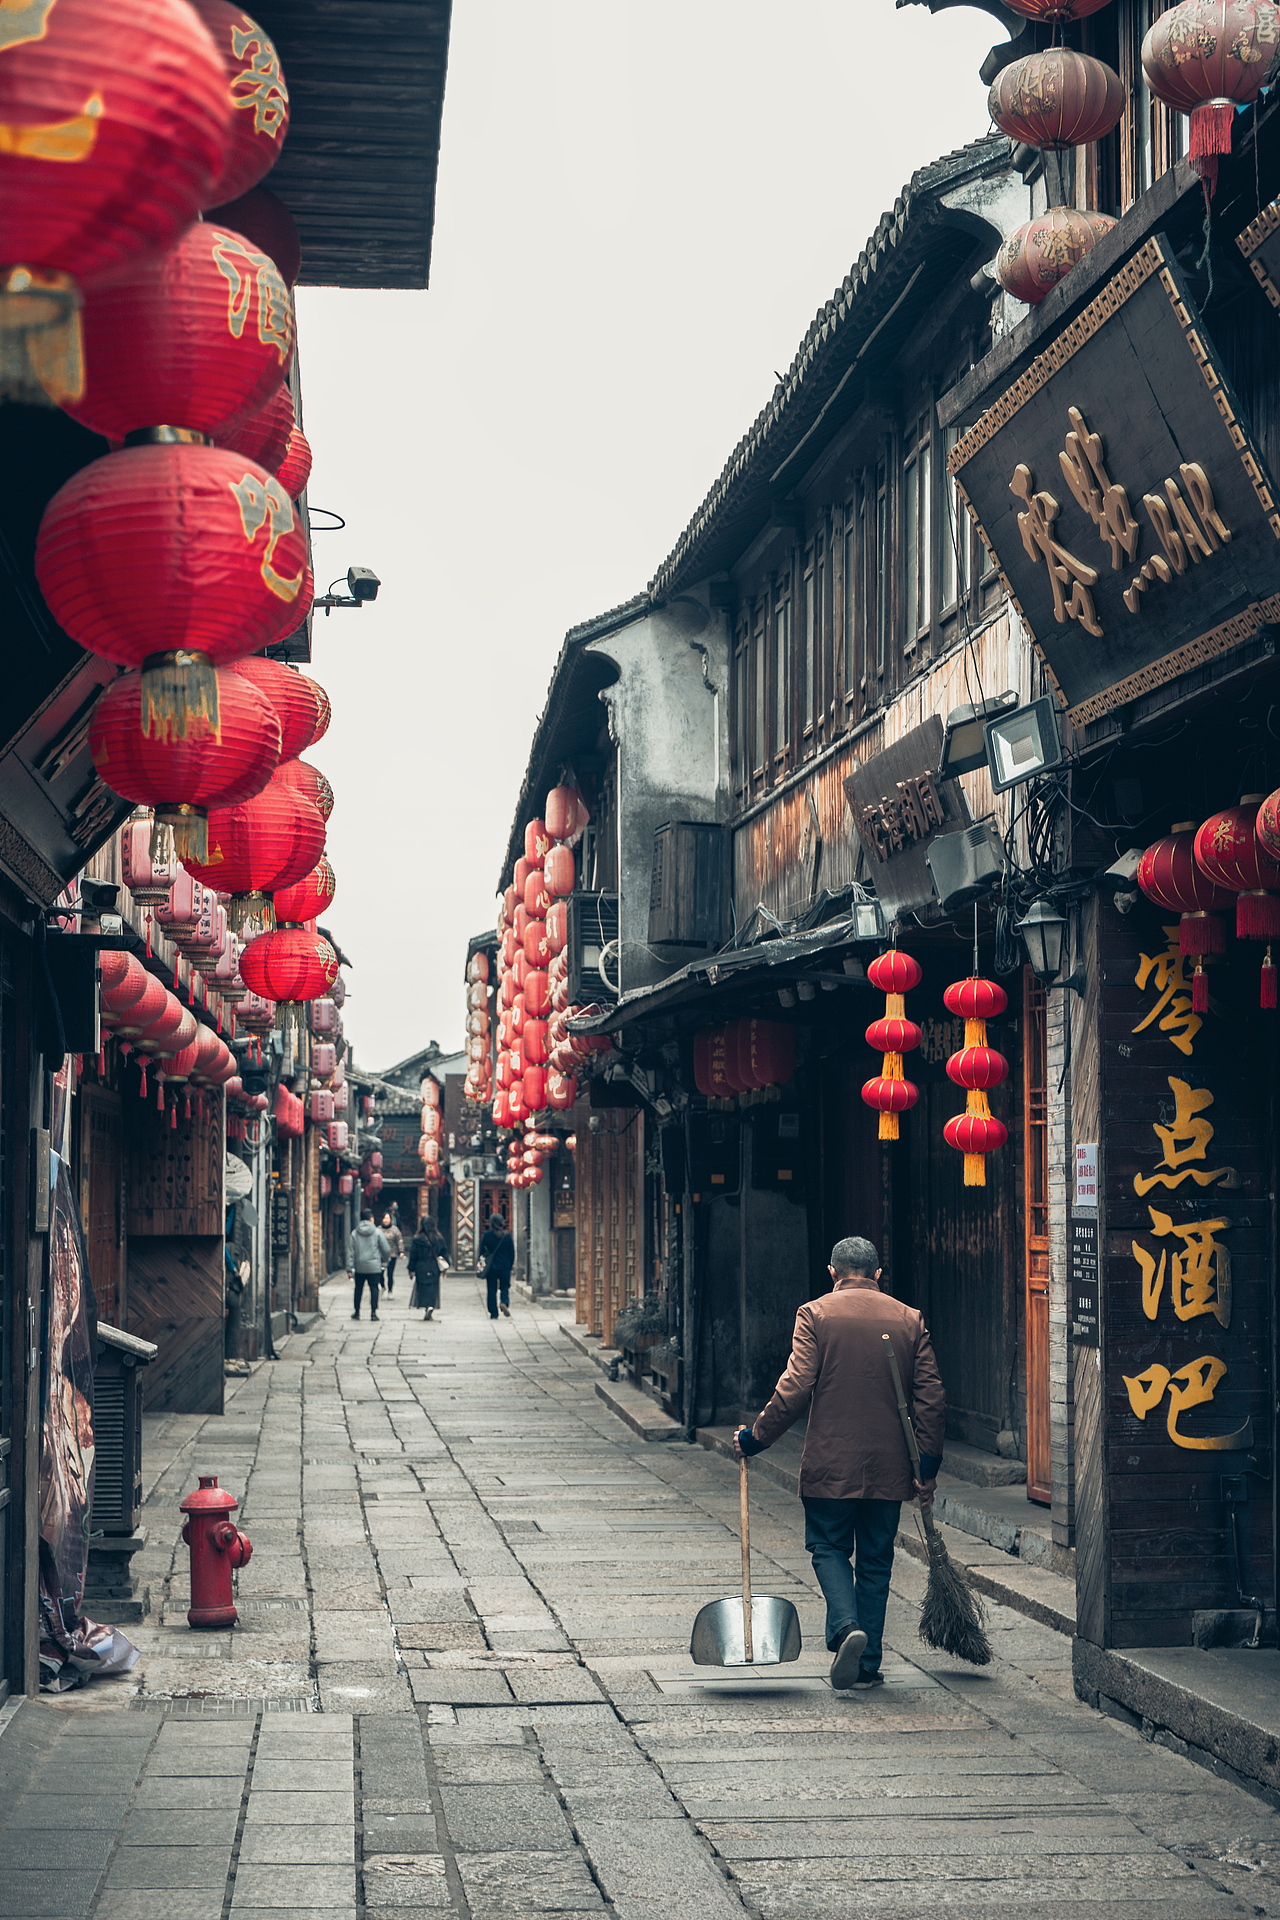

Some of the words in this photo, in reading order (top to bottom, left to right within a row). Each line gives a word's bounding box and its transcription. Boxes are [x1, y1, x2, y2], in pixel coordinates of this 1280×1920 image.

[228, 473, 305, 603] 吧
[1142, 462, 1233, 576] BAR
[1122, 925, 1255, 1451] 零点酒吧
